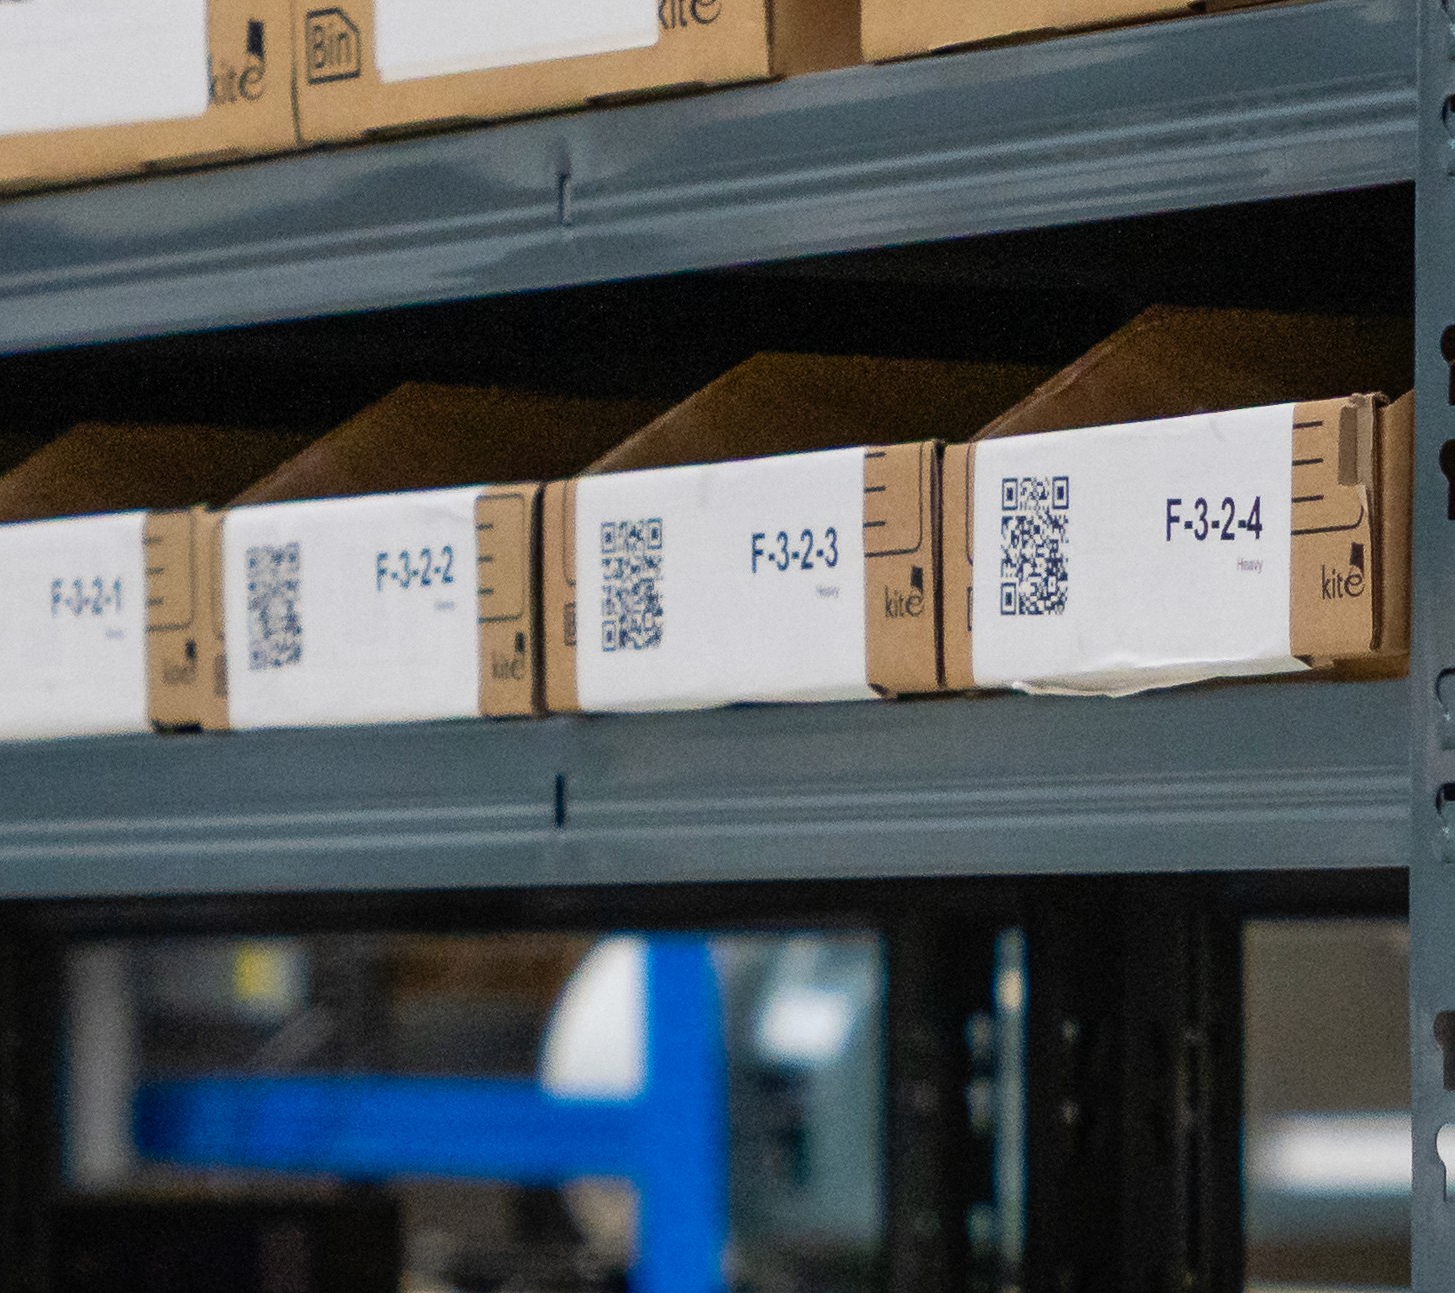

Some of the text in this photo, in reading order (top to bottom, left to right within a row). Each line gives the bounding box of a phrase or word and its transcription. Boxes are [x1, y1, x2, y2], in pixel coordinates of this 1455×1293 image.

[312, 24, 350, 68] Bin
[1165, 495, 1263, 542] F-3-2-4
[376, 545, 454, 591] F-3-2-2
[750, 526, 838, 574] F-3-2-3
[1236, 557, 1264, 574] Heavy
[50, 577, 123, 617] F-3-2-1
[884, 581, 925, 618] kite
[1320, 562, 1366, 600] kite
